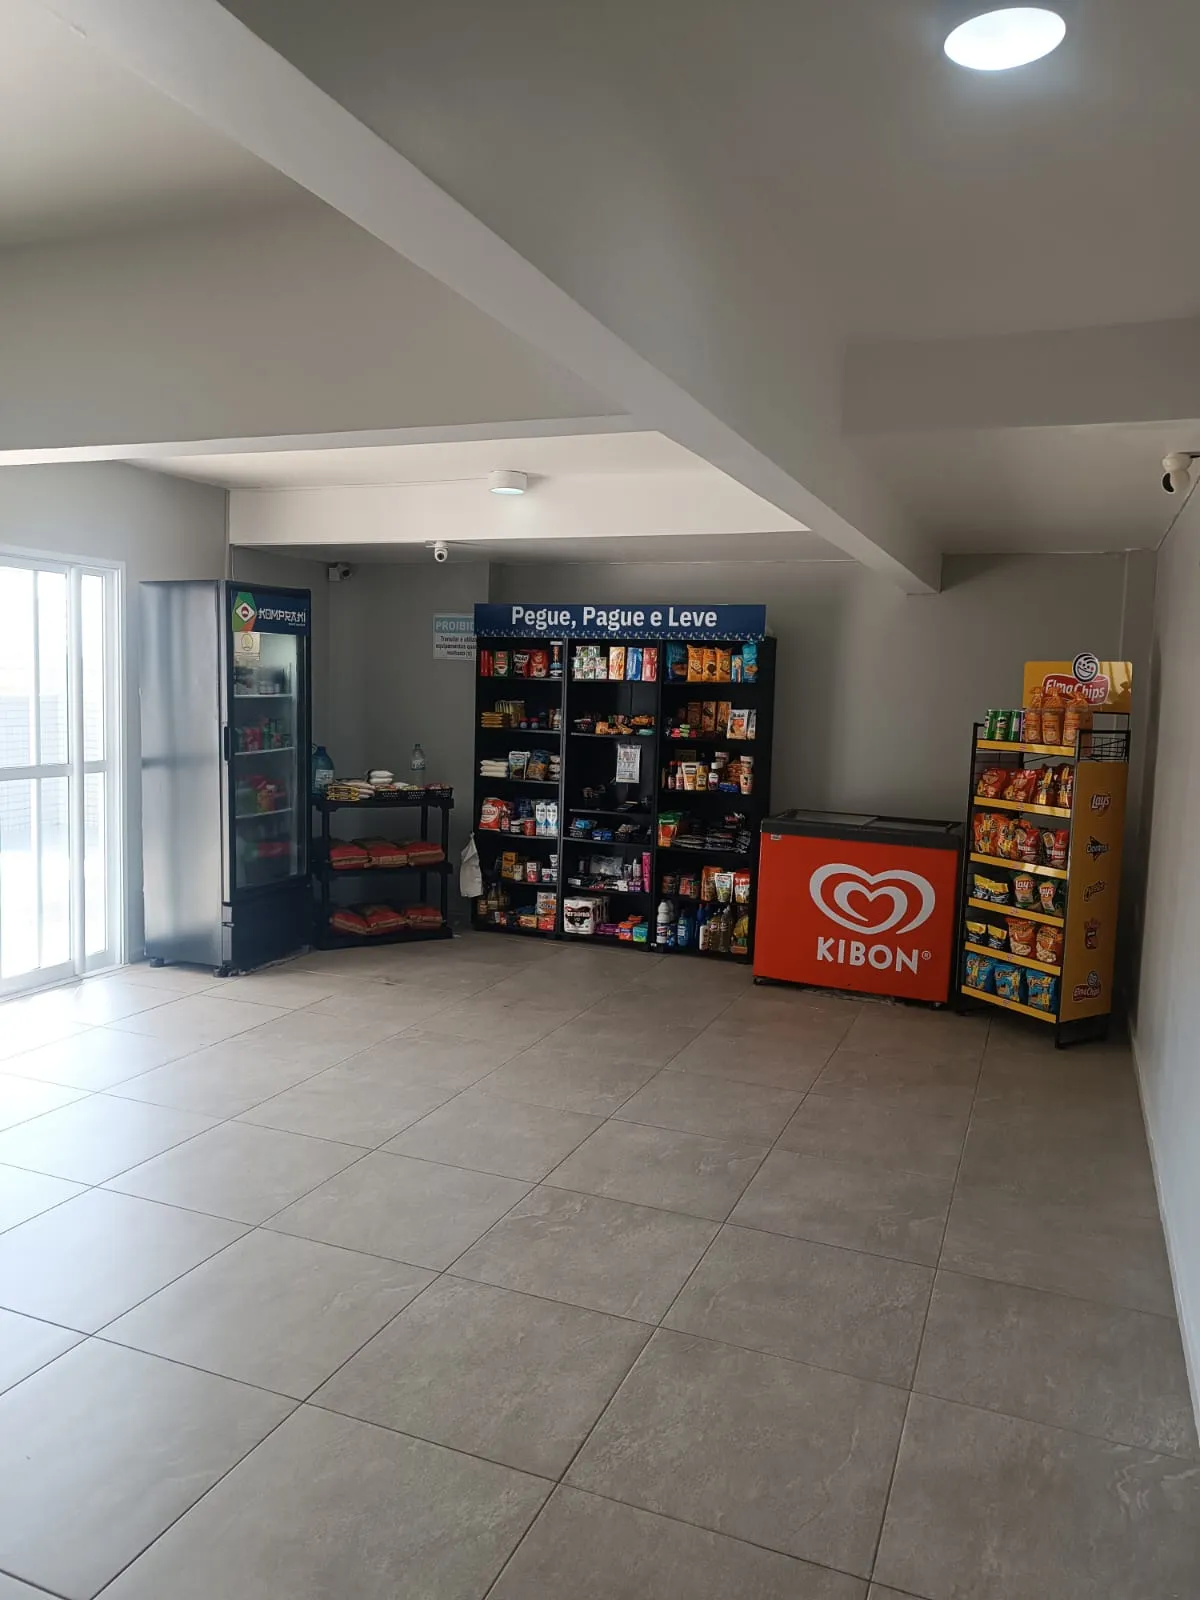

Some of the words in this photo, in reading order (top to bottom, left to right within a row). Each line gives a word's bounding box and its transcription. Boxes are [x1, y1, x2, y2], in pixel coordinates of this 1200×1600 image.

[511, 606, 577, 630] Pegue,
[583, 606, 645, 631] Pague
[650, 610, 663, 626] e
[668, 607, 718, 627] Leve
